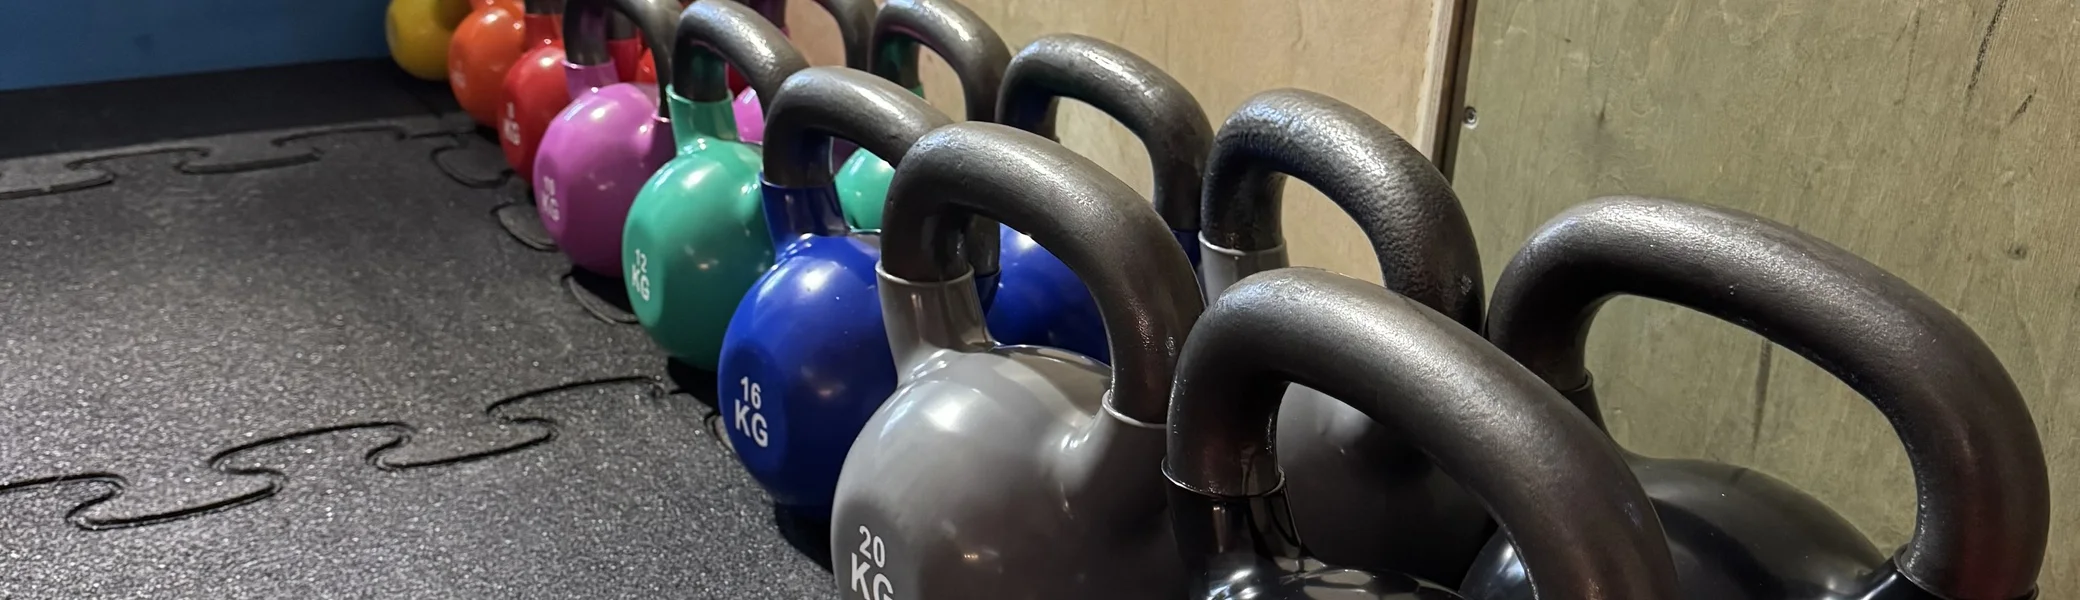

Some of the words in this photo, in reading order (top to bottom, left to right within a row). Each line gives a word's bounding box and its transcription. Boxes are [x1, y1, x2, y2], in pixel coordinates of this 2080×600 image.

[635, 249, 647, 273] 12
[632, 264, 650, 301] KG
[740, 376, 762, 409] 16
[734, 399, 768, 447] KG
[859, 525, 885, 568] 20
[851, 552, 893, 600] KG
